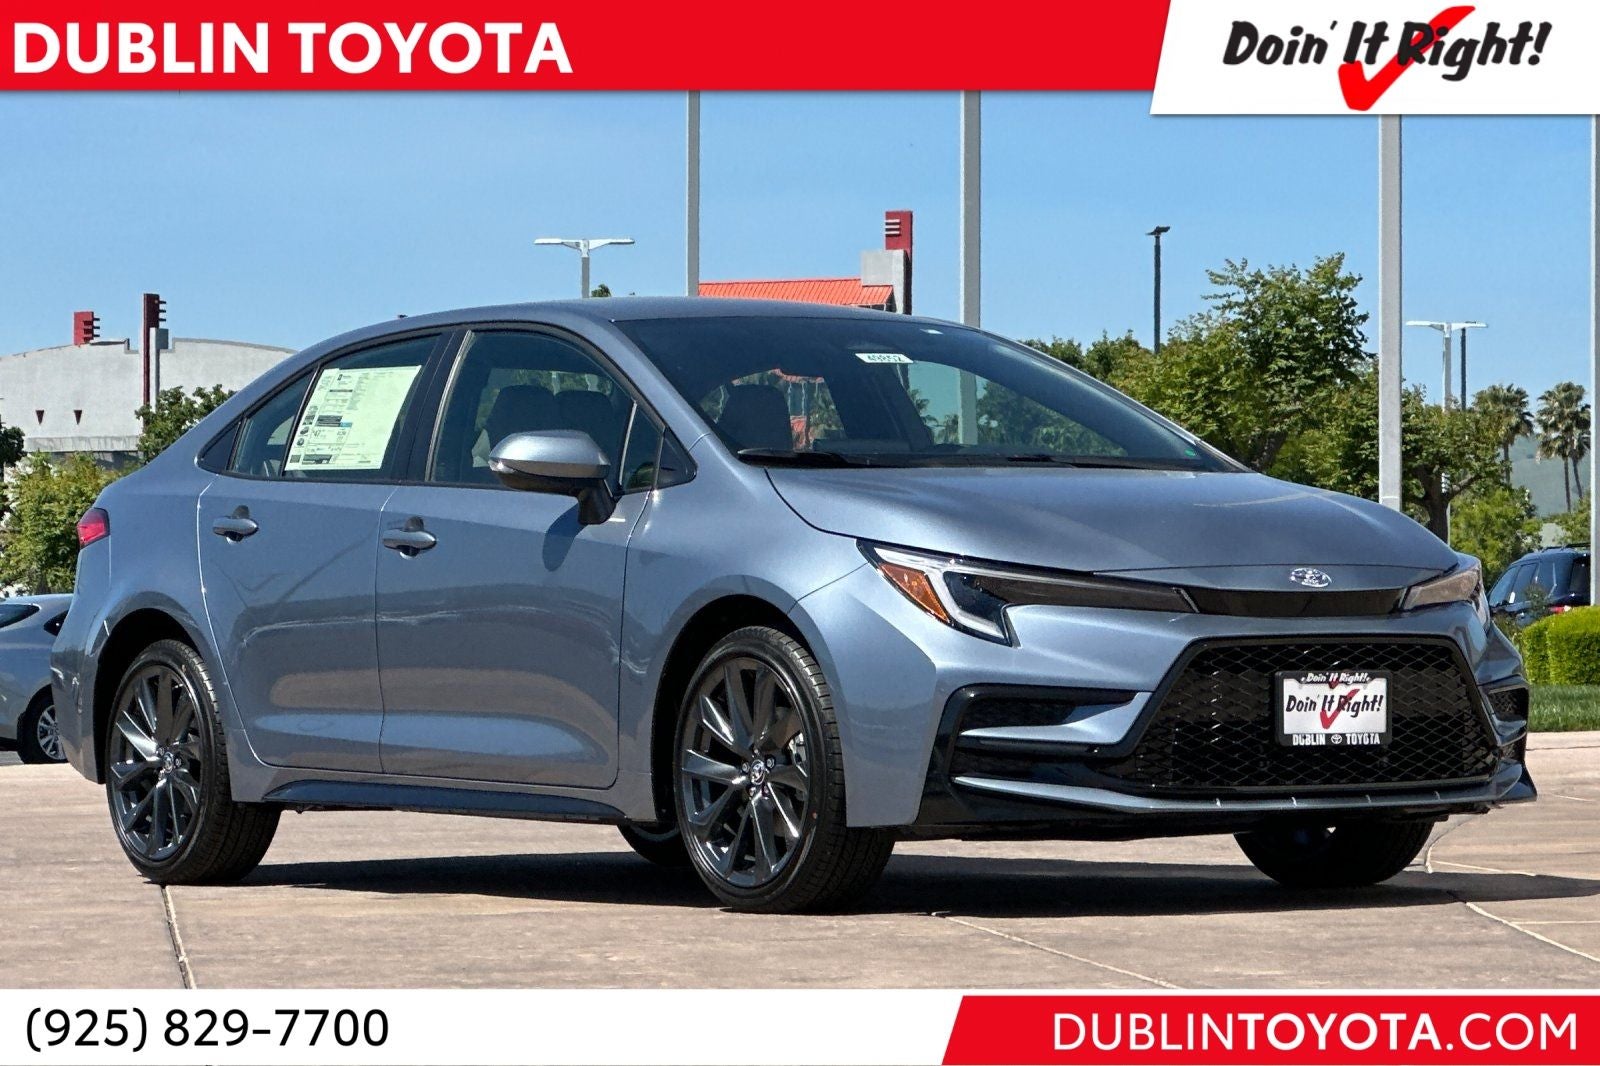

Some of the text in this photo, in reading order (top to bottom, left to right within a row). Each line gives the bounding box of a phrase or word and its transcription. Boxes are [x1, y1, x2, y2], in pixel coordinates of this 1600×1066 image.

[1323, 694, 1335, 712] It
[1339, 694, 1384, 718] Right!
[1292, 733, 1381, 746] DUBLIN TOYOTA
